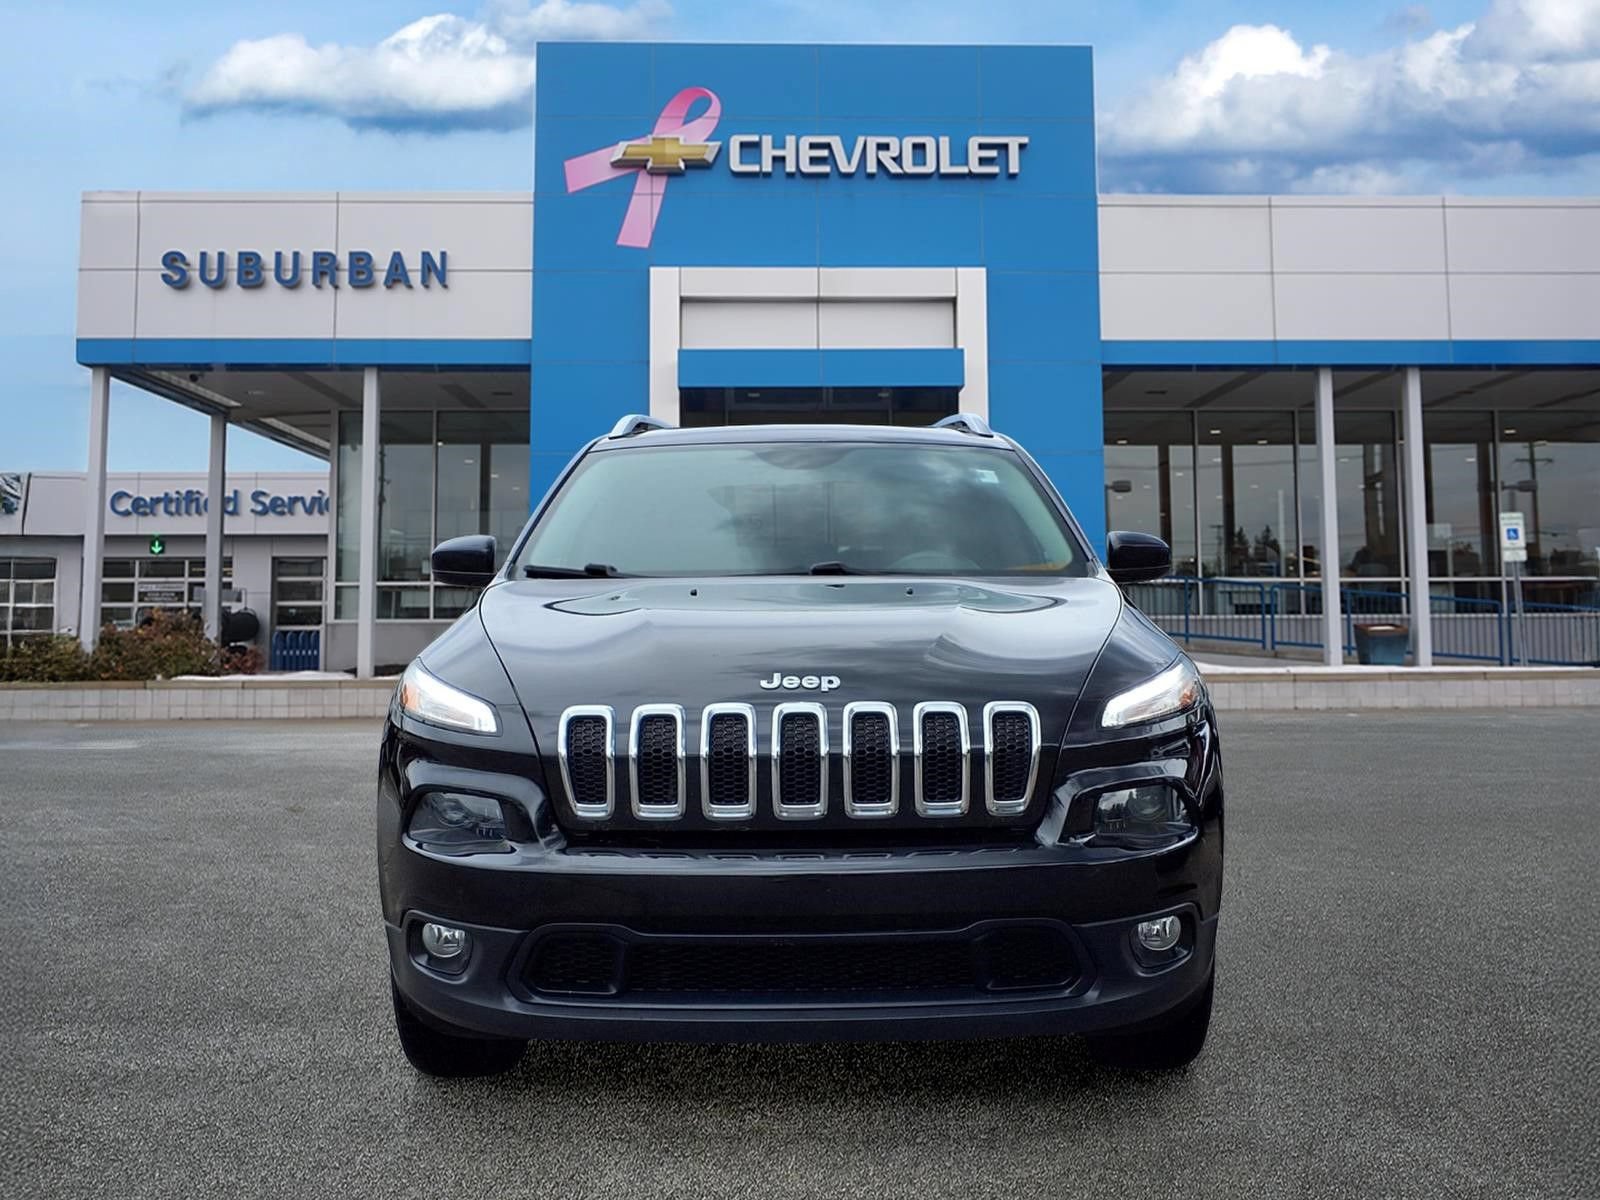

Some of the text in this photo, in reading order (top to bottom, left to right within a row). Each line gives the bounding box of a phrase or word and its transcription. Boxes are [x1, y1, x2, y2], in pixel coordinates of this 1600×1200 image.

[729, 134, 1029, 176] CHEVROLET
[161, 250, 448, 288] SUBURBAN
[109, 490, 239, 516] Certifid
[760, 672, 841, 692] Jeep
